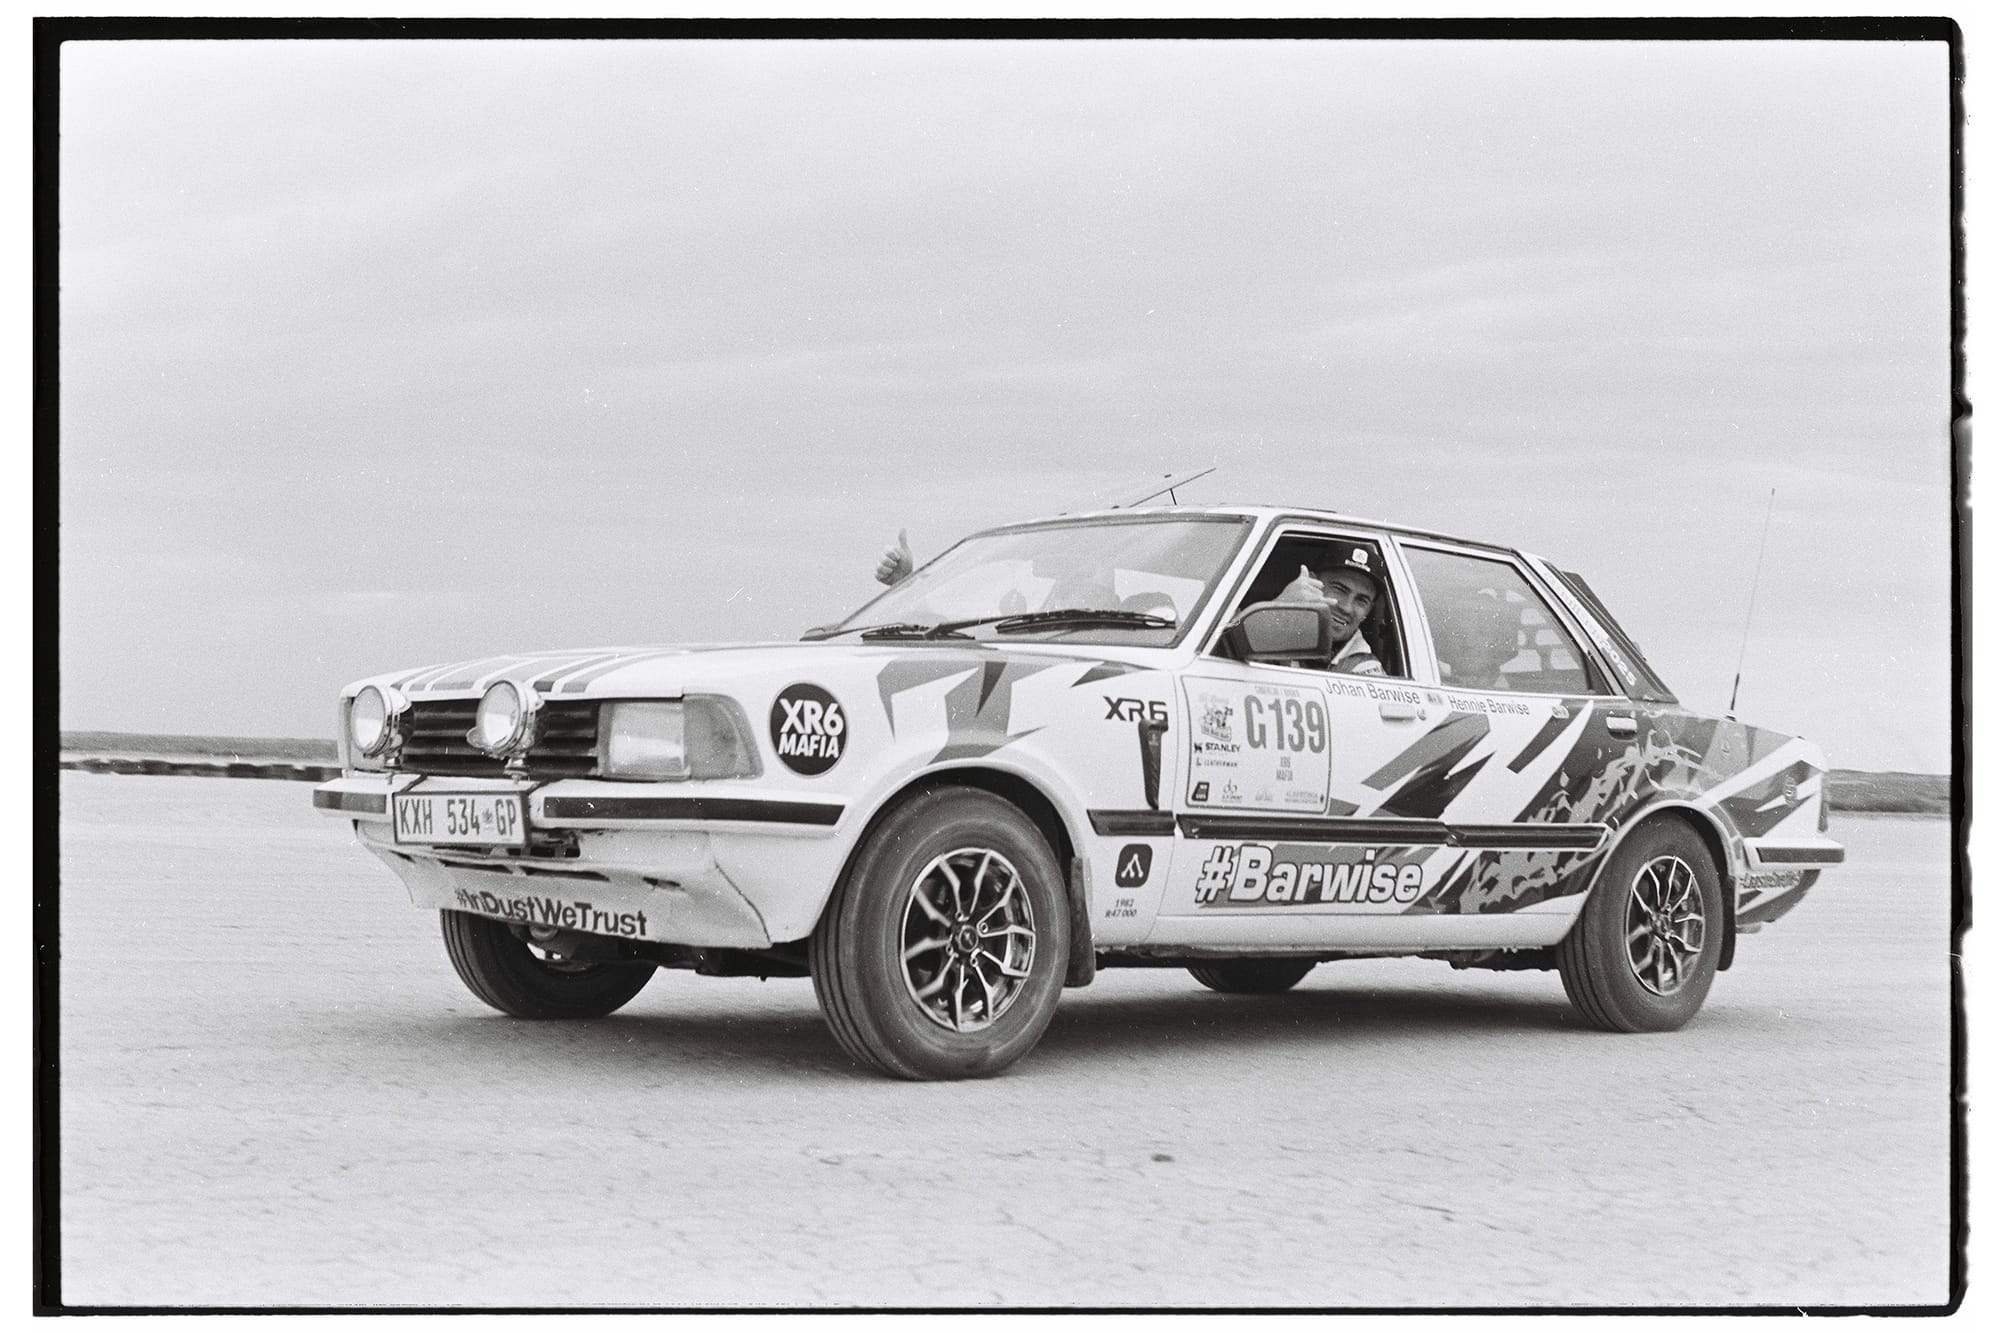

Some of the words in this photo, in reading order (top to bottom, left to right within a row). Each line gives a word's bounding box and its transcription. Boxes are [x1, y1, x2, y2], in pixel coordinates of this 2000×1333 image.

[1600, 639, 1637, 686] 2025
[1325, 679, 1366, 698] Johan
[1368, 683, 1421, 705] Barwise
[1448, 695, 1488, 713] Hennie
[1489, 700, 1531, 716] Barwise
[779, 698, 844, 737] XR6
[1102, 695, 1169, 732] XR6
[1244, 694, 1326, 753] G139
[778, 733, 840, 759] MAFIA
[1204, 742, 1241, 753] STANLEY
[399, 798, 432, 834] KXH
[447, 798, 480, 835] 534
[495, 798, 516, 835] GP
[1195, 843, 1423, 903] #Barwise
[454, 888, 648, 937] #InDustWeTrust
